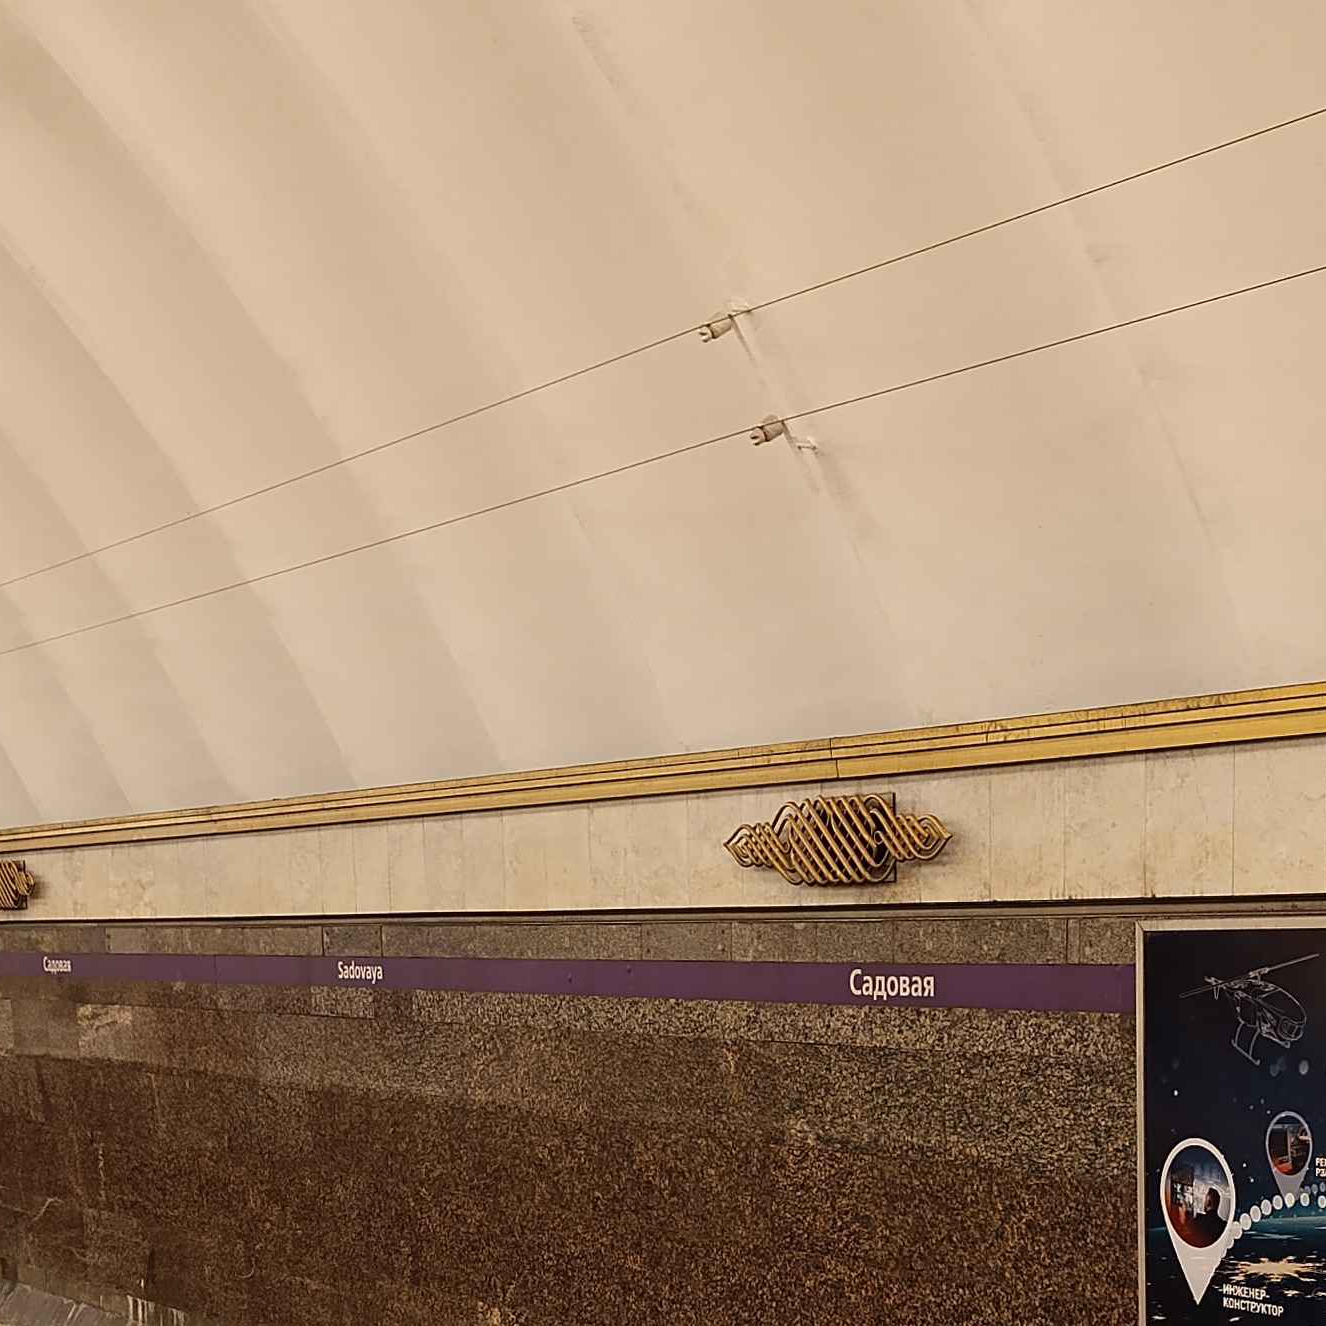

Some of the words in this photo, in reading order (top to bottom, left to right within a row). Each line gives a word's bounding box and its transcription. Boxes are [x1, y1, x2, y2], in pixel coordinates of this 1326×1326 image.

[42, 956, 72, 975] Садовая
[337, 961, 384, 984] Sadovaya
[849, 968, 935, 1001] Садовая
[1222, 1297, 1284, 1317] КОНСТРУКТОР
